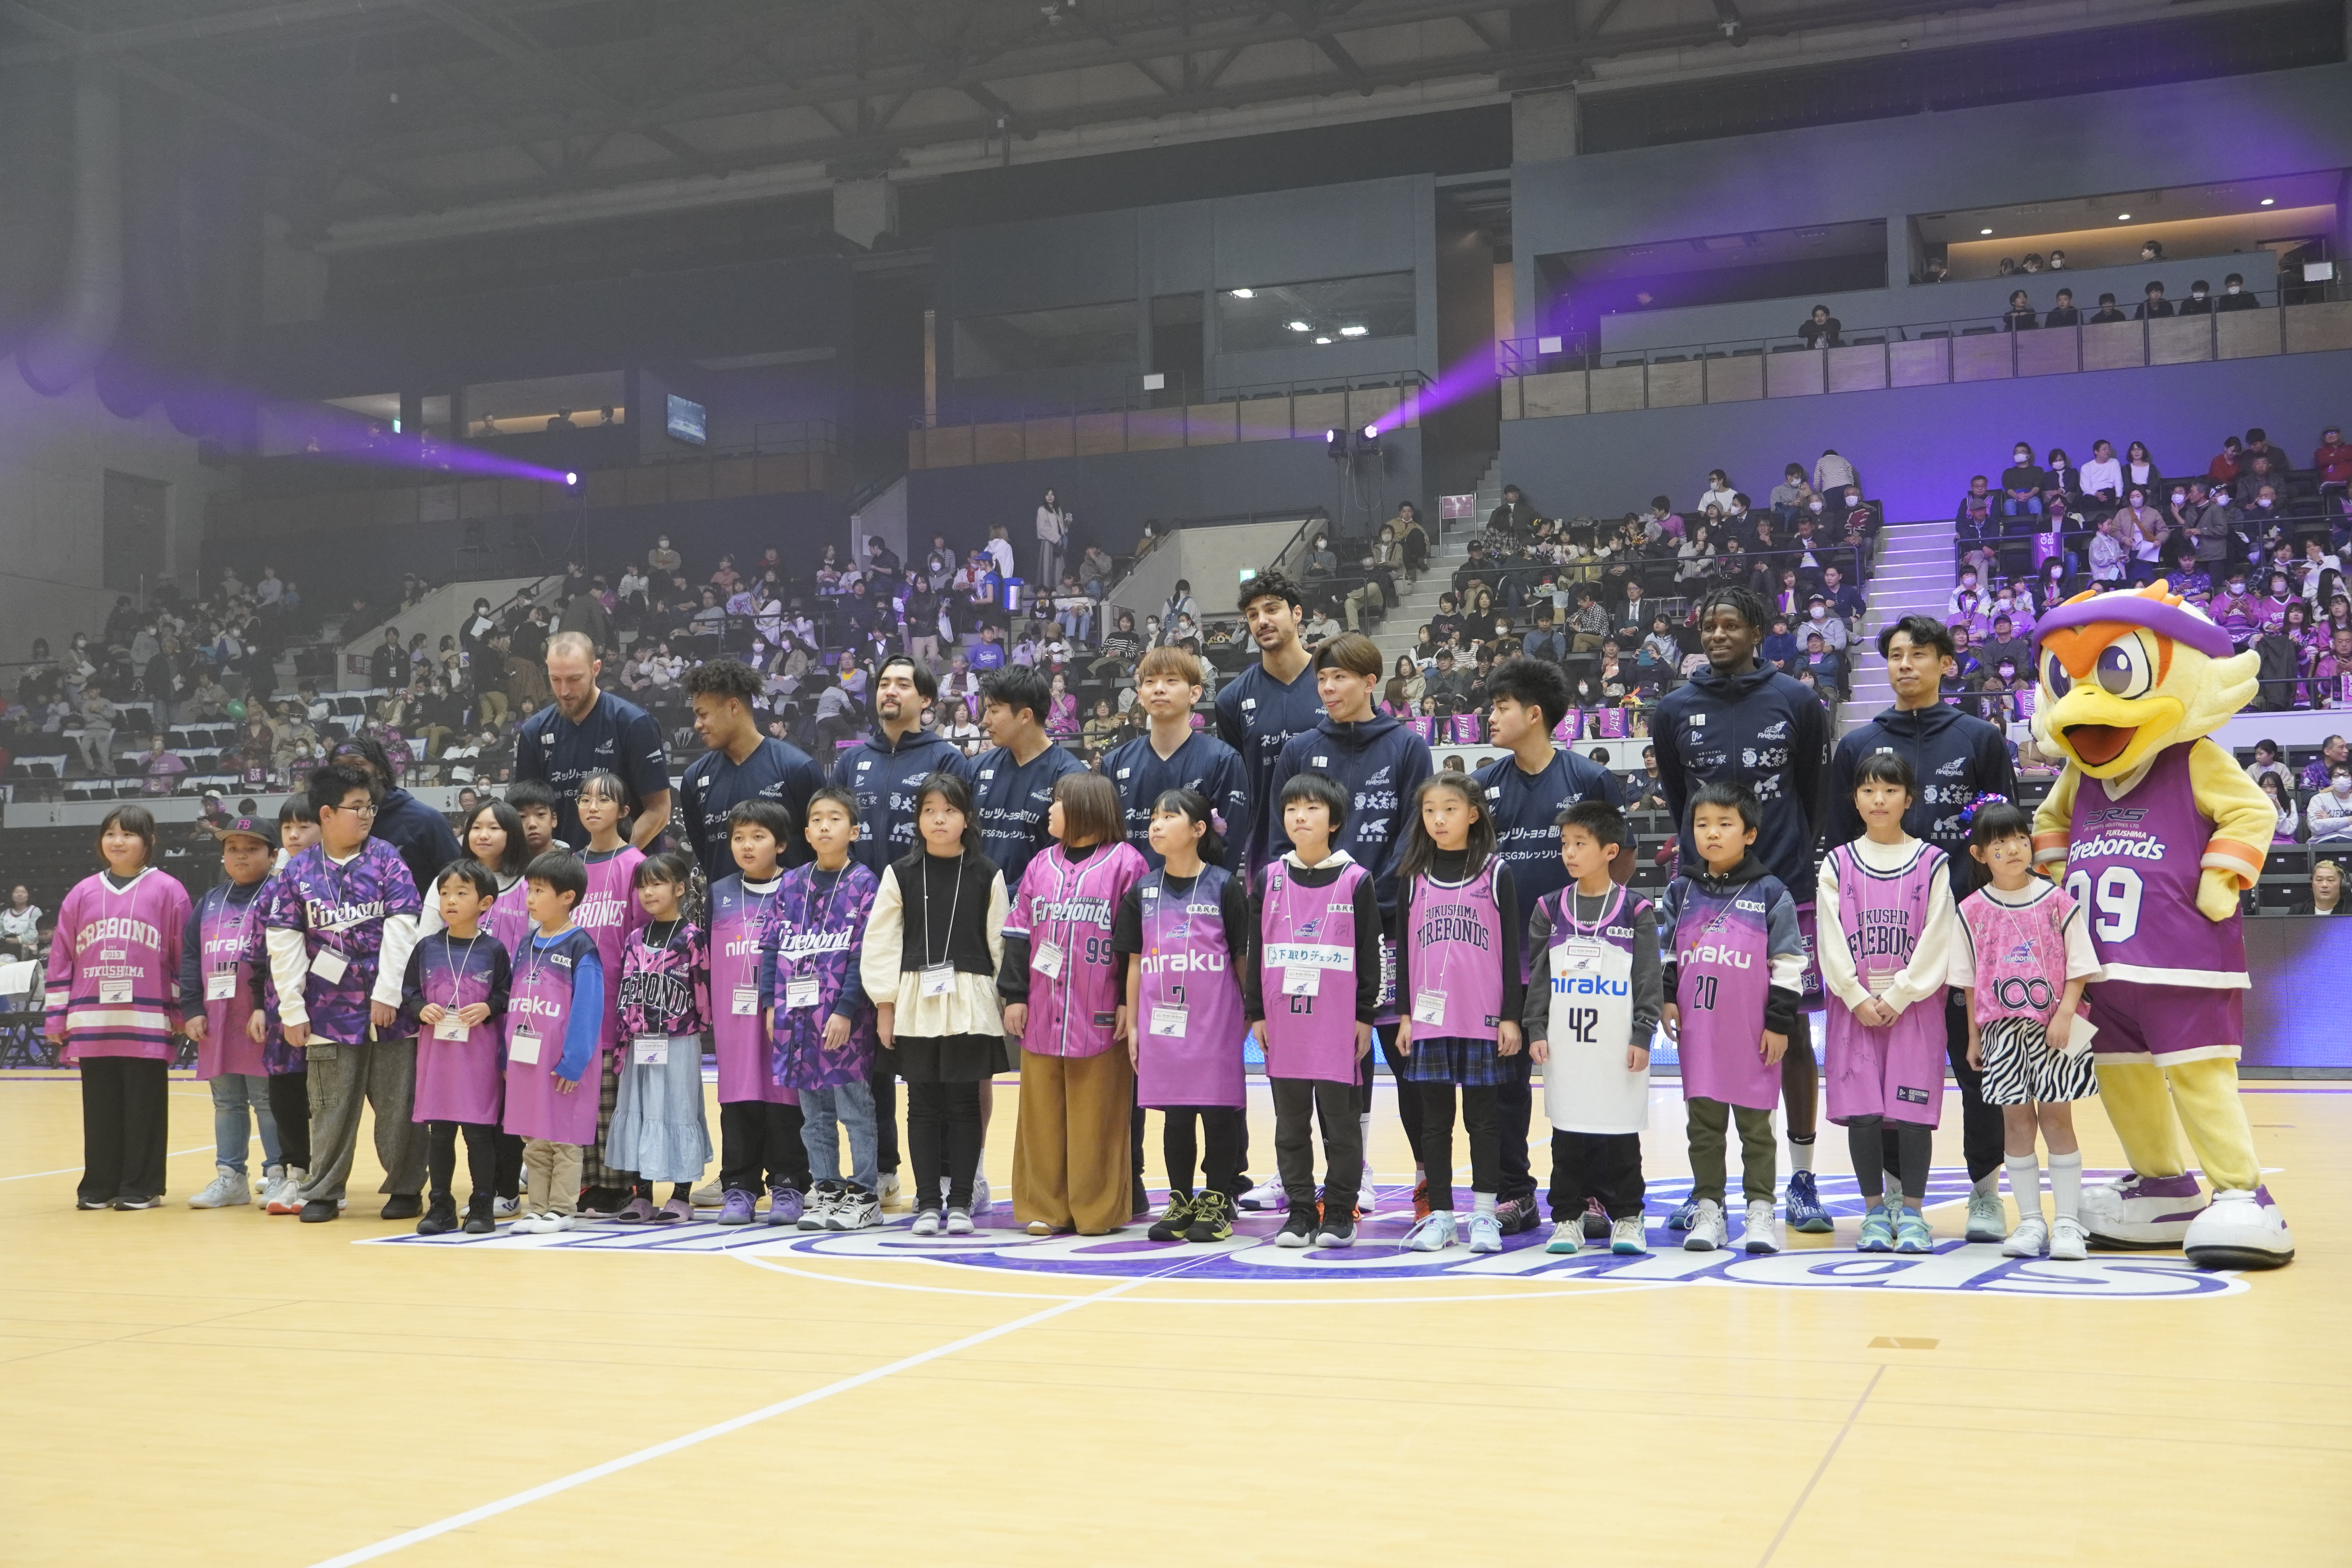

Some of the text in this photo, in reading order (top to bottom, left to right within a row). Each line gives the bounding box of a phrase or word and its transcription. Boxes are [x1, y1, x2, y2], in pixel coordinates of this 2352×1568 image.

[1460, 716, 1469, 739] 新川
[1031, 792, 1053, 802] Firebonds
[236, 819, 251, 830] FB
[2105, 829, 2147, 839] FUKUSHIMA
[2067, 835, 2167, 866] Firebonds
[583, 891, 612, 902] USHIMA
[2065, 866, 2144, 943] 99
[1031, 895, 1112, 931] Firebonds
[1187, 905, 1219, 915] 福島民報
[1424, 904, 1478, 922] FUKUSHIMA
[205, 934, 245, 955] nirak
[726, 935, 764, 957] nira
[779, 920, 854, 951] Firebond
[1417, 918, 1489, 953] FIREBONDS
[1084, 936, 1114, 966] 99
[1141, 947, 1224, 974] niraku
[1279, 949, 1349, 964] 下取りチェッカー
[1681, 941, 1752, 969] niraku
[83, 965, 144, 978] FUKUSHIMA
[670, 969, 690, 977] Firebond
[1551, 970, 1628, 996] niraku
[1693, 974, 1719, 1011] 20
[1290, 995, 1313, 1014] 21
[1569, 1007, 1598, 1043] 42
